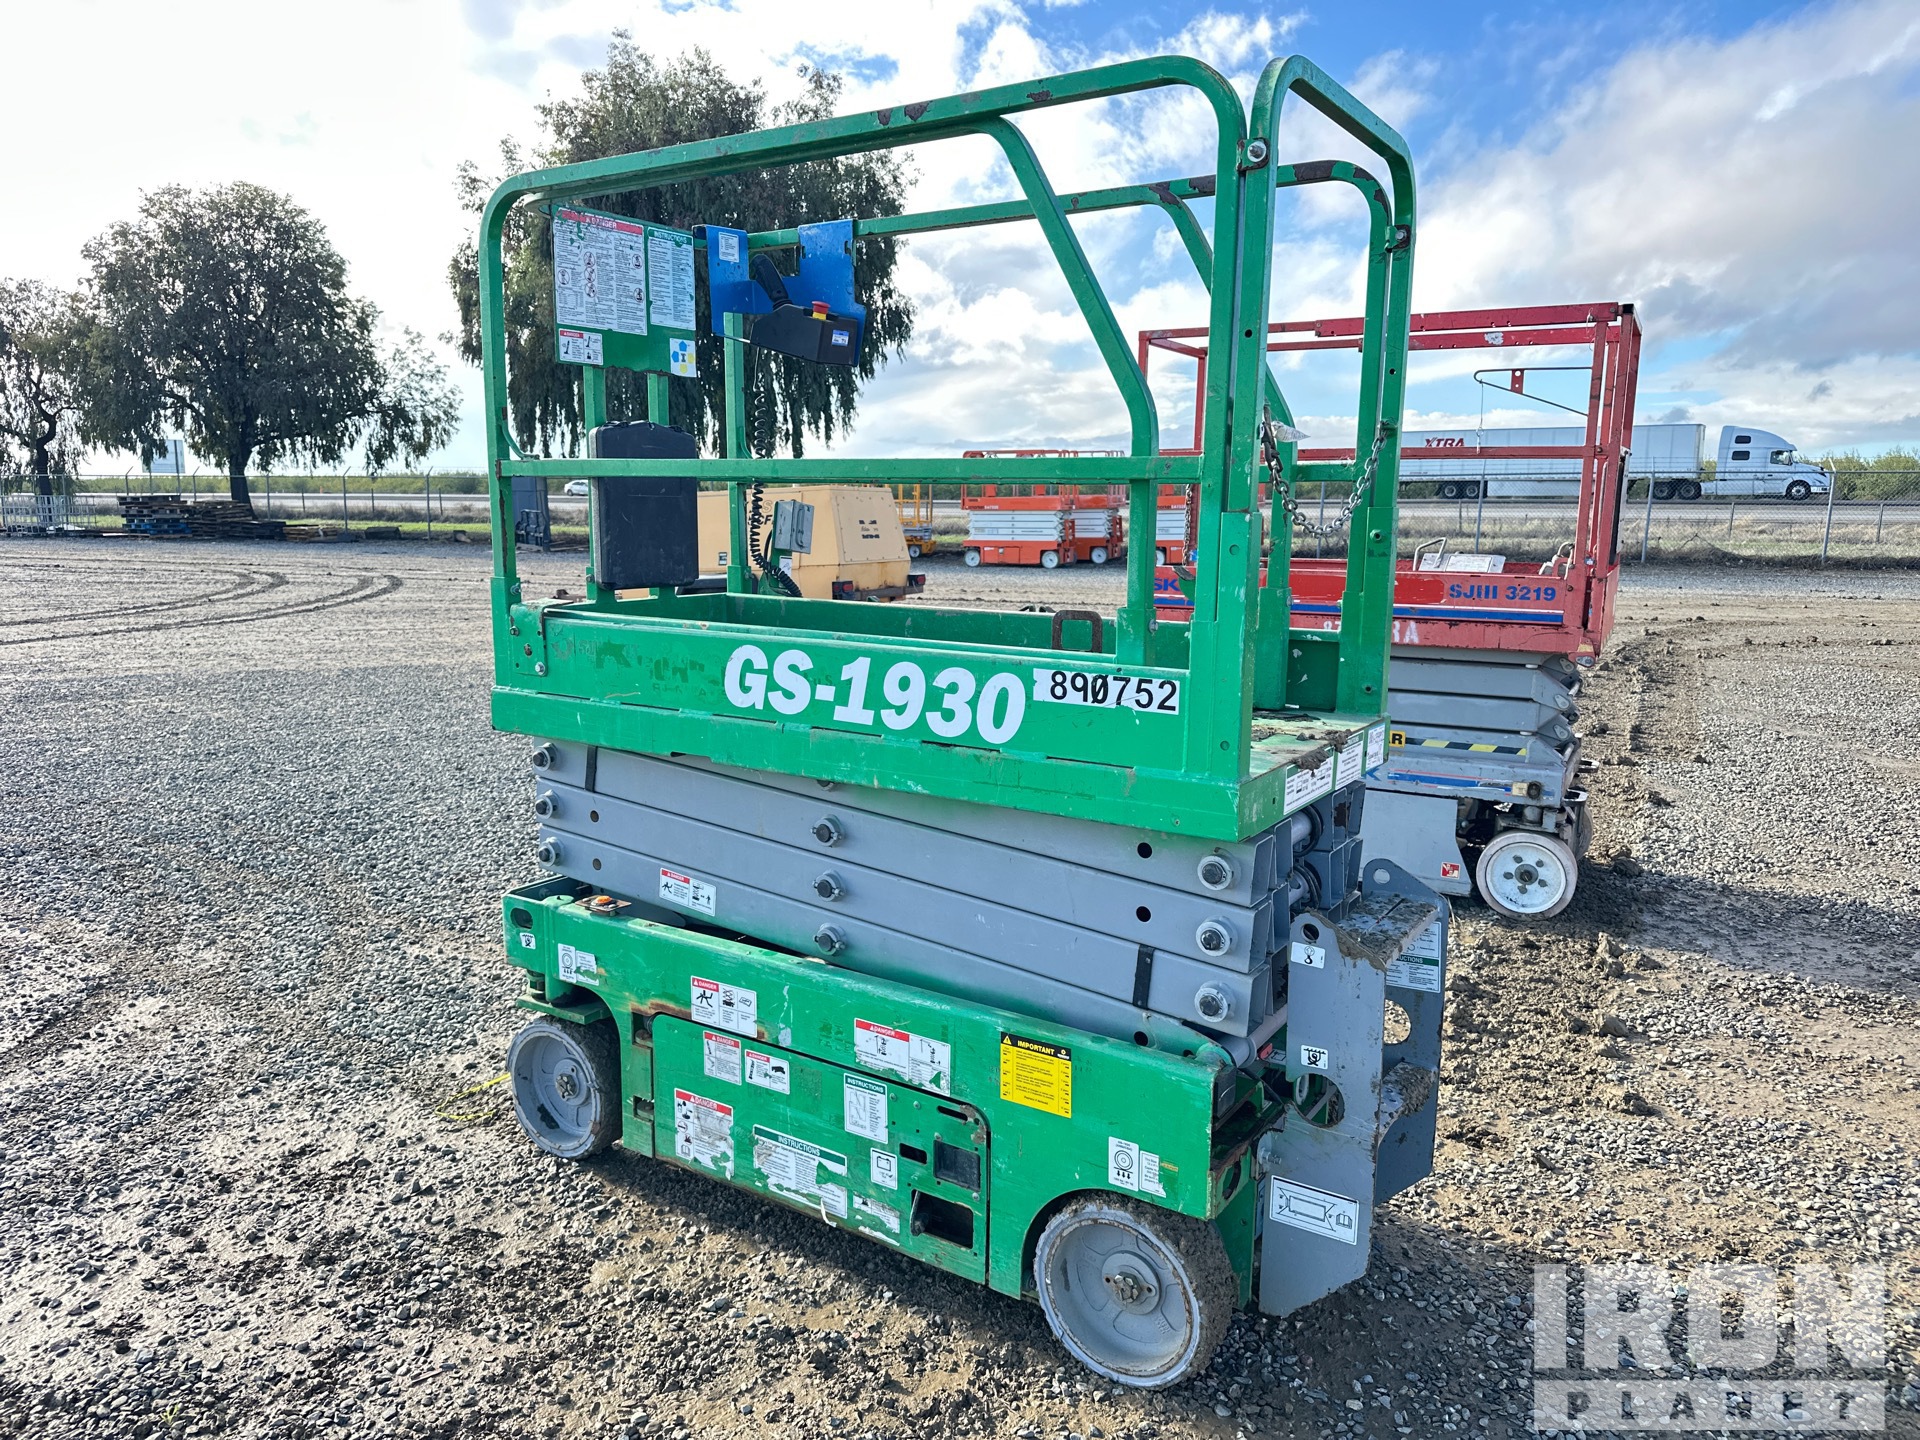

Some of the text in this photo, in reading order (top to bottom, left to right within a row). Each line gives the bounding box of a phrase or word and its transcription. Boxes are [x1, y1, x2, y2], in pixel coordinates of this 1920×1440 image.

[591, 217, 617, 229] DANGER
[1424, 437, 1465, 447] XTRA
[1505, 585, 1557, 602] 3219
[724, 643, 1026, 745] GS-1930
[1050, 670, 1177, 712] 890752
[698, 980, 718, 990] DANGER
[874, 1026, 896, 1037] DANGER
[716, 1036, 735, 1047] DANGER
[1017, 1040, 1055, 1056] IMPORTANT
[847, 1077, 884, 1093] INSTRUCTIONS
[694, 1097, 718, 1111] DANGER
[777, 1135, 821, 1157] INSTRUCTIONS
